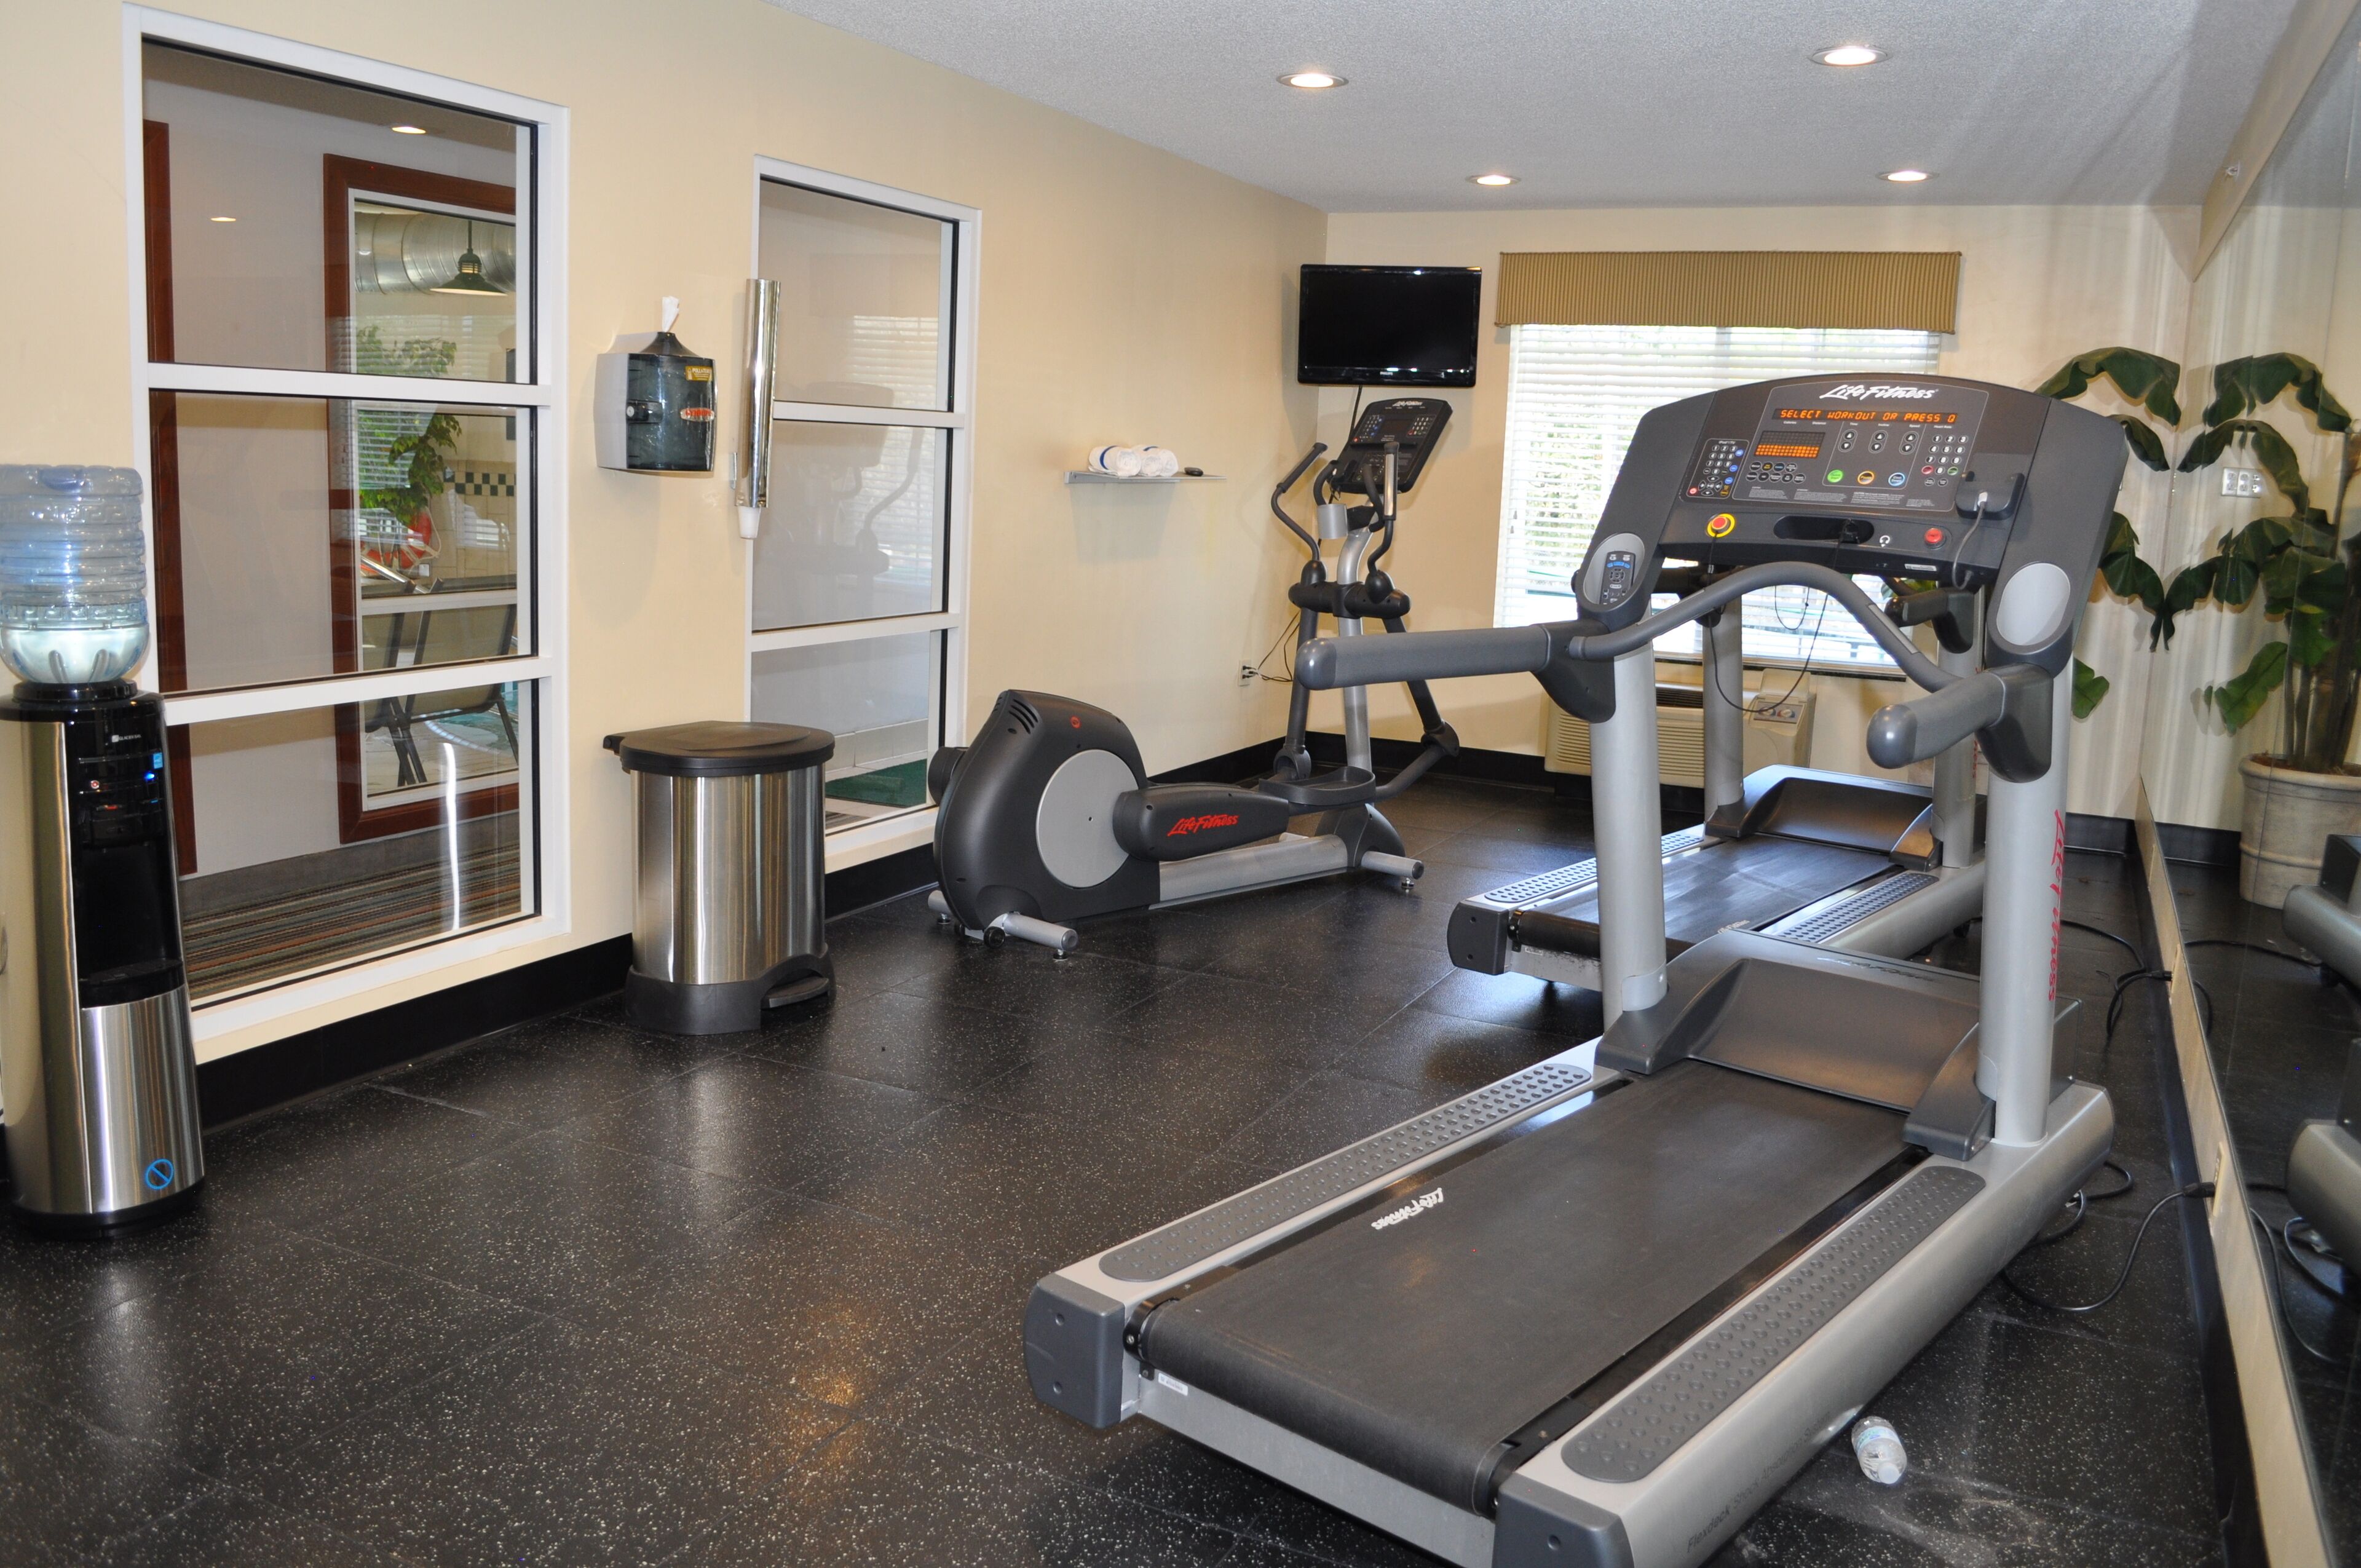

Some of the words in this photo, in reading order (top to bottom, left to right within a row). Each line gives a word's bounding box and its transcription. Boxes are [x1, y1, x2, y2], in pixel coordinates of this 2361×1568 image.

[1781, 410, 1821, 419] SELECT
[1827, 411, 1876, 420] WORKOUT
[1904, 413, 1940, 422] PRESS
[1687, 1504, 1730, 1553] Flexdeck
